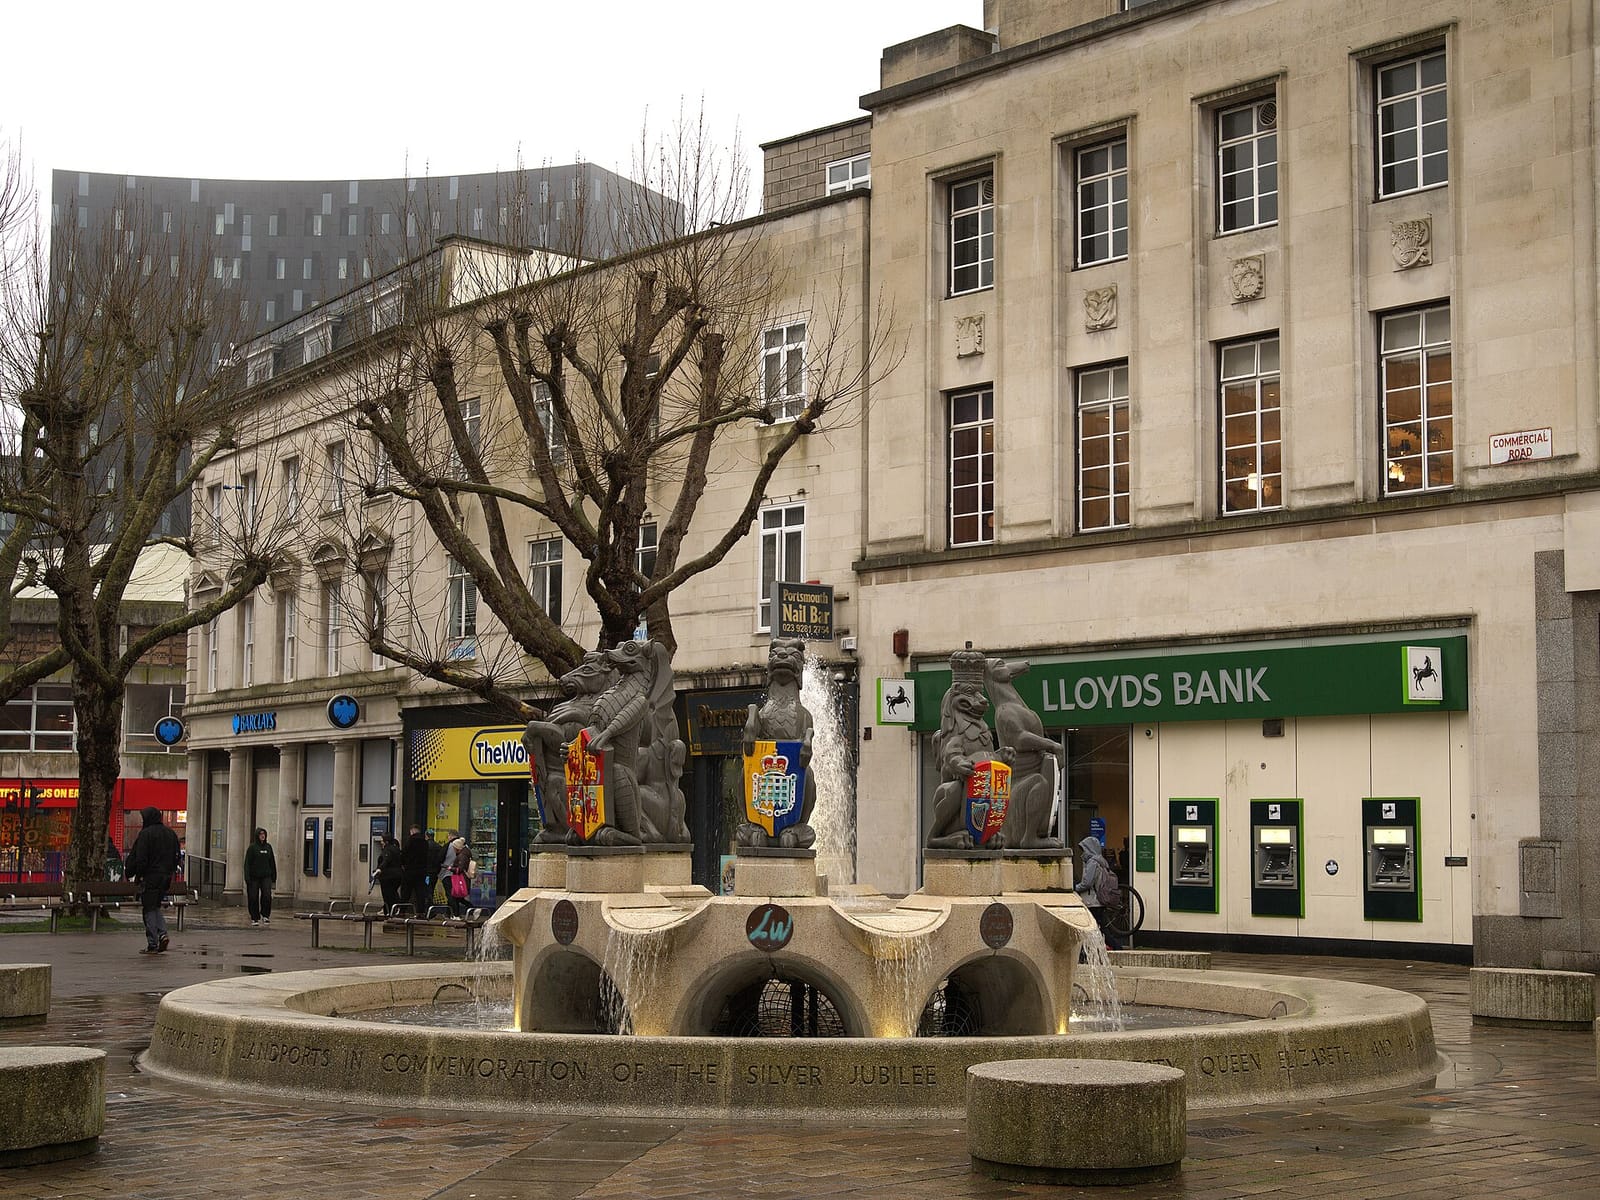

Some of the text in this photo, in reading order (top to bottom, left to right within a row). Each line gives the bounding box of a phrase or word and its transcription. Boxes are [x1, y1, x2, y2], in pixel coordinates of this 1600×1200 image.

[1493, 432, 1549, 448] COMMERCIAL
[1509, 447, 1533, 459] ROAD
[782, 588, 829, 604] Portsmouth
[782, 603, 830, 624] Nail Bar
[782, 623, 795, 632] 023
[1042, 666, 1271, 712] LLOYDS BANK
[240, 711, 277, 732] BARCLAYS
[54, 788, 67, 798] ON
[241, 1042, 330, 1067] LANDPORTS
[345, 1050, 363, 1070] IN
[381, 1053, 588, 1081] COMMEMORATION
[612, 1062, 644, 1082] OF
[669, 1064, 718, 1084] THE
[747, 1065, 822, 1085] SILVER
[849, 1065, 937, 1085] JUBILEE
[1201, 1053, 1262, 1077] QUEEN
[1277, 1046, 1352, 1069] ELIZABETH
